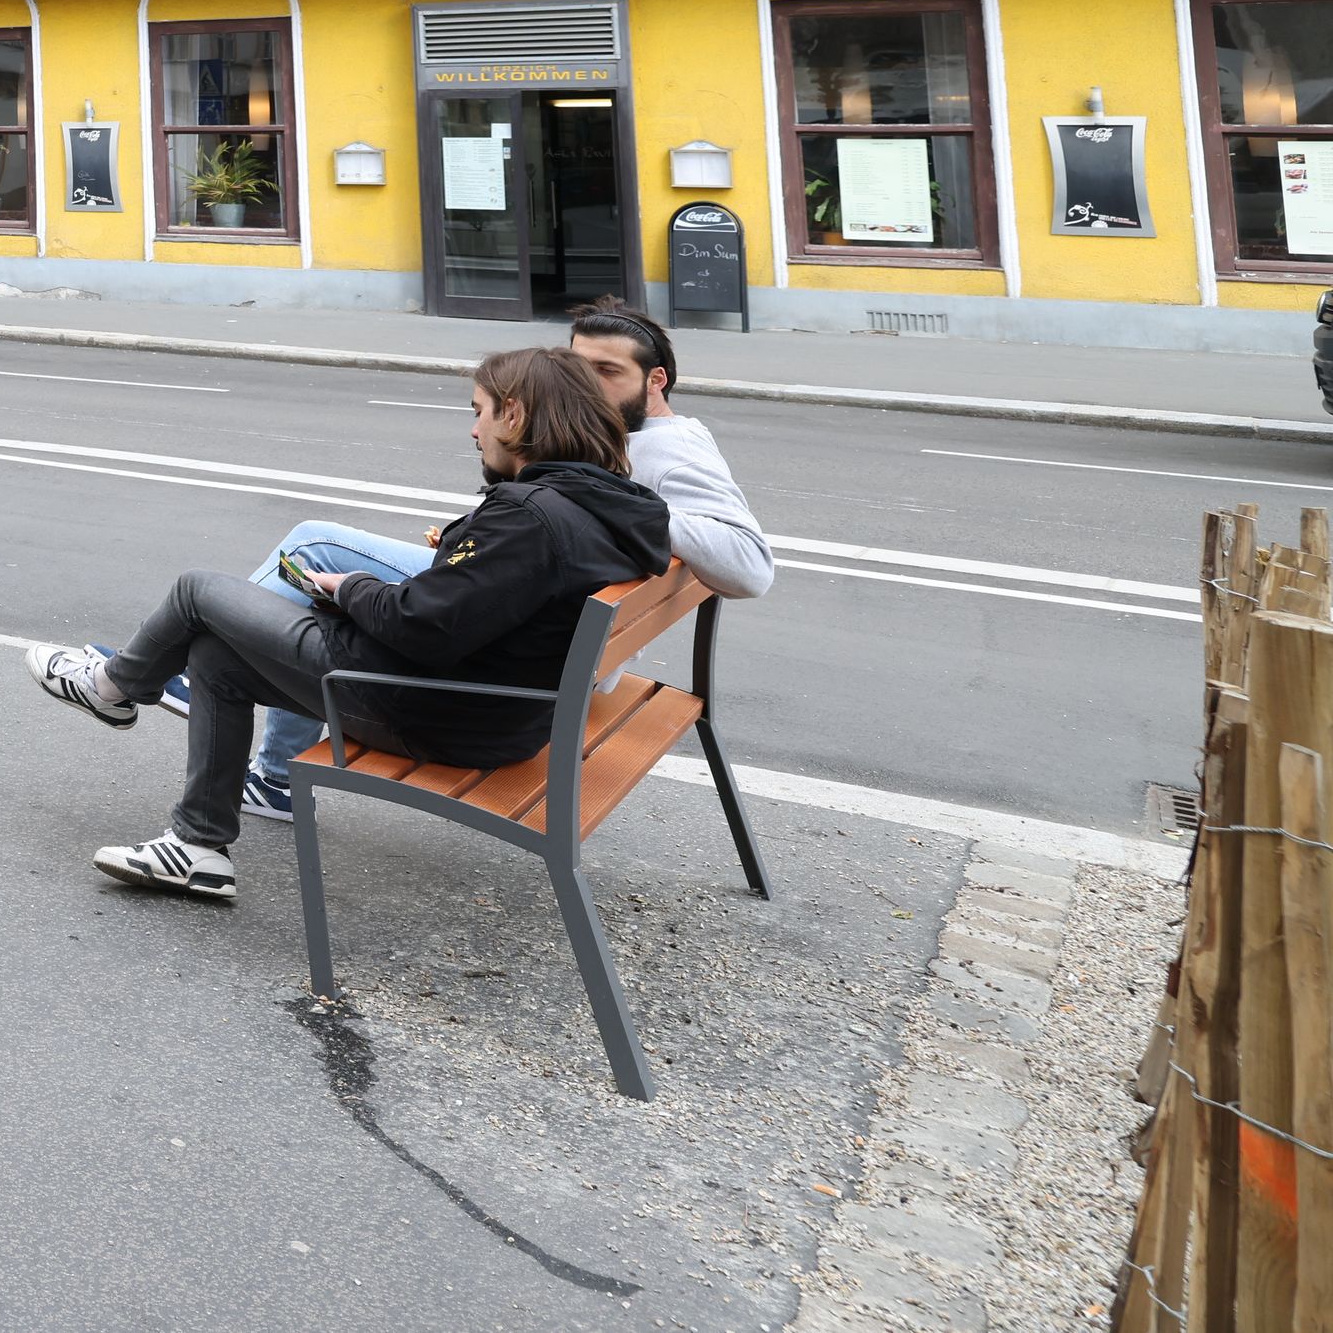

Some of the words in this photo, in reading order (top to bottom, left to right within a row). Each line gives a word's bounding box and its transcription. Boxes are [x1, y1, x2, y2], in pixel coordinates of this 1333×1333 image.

[435, 70, 609, 82] WILLKOMMEN
[685, 211, 723, 223] Coca-Cola
[678, 242, 710, 259] Dim
[714, 243, 739, 261] Sum
